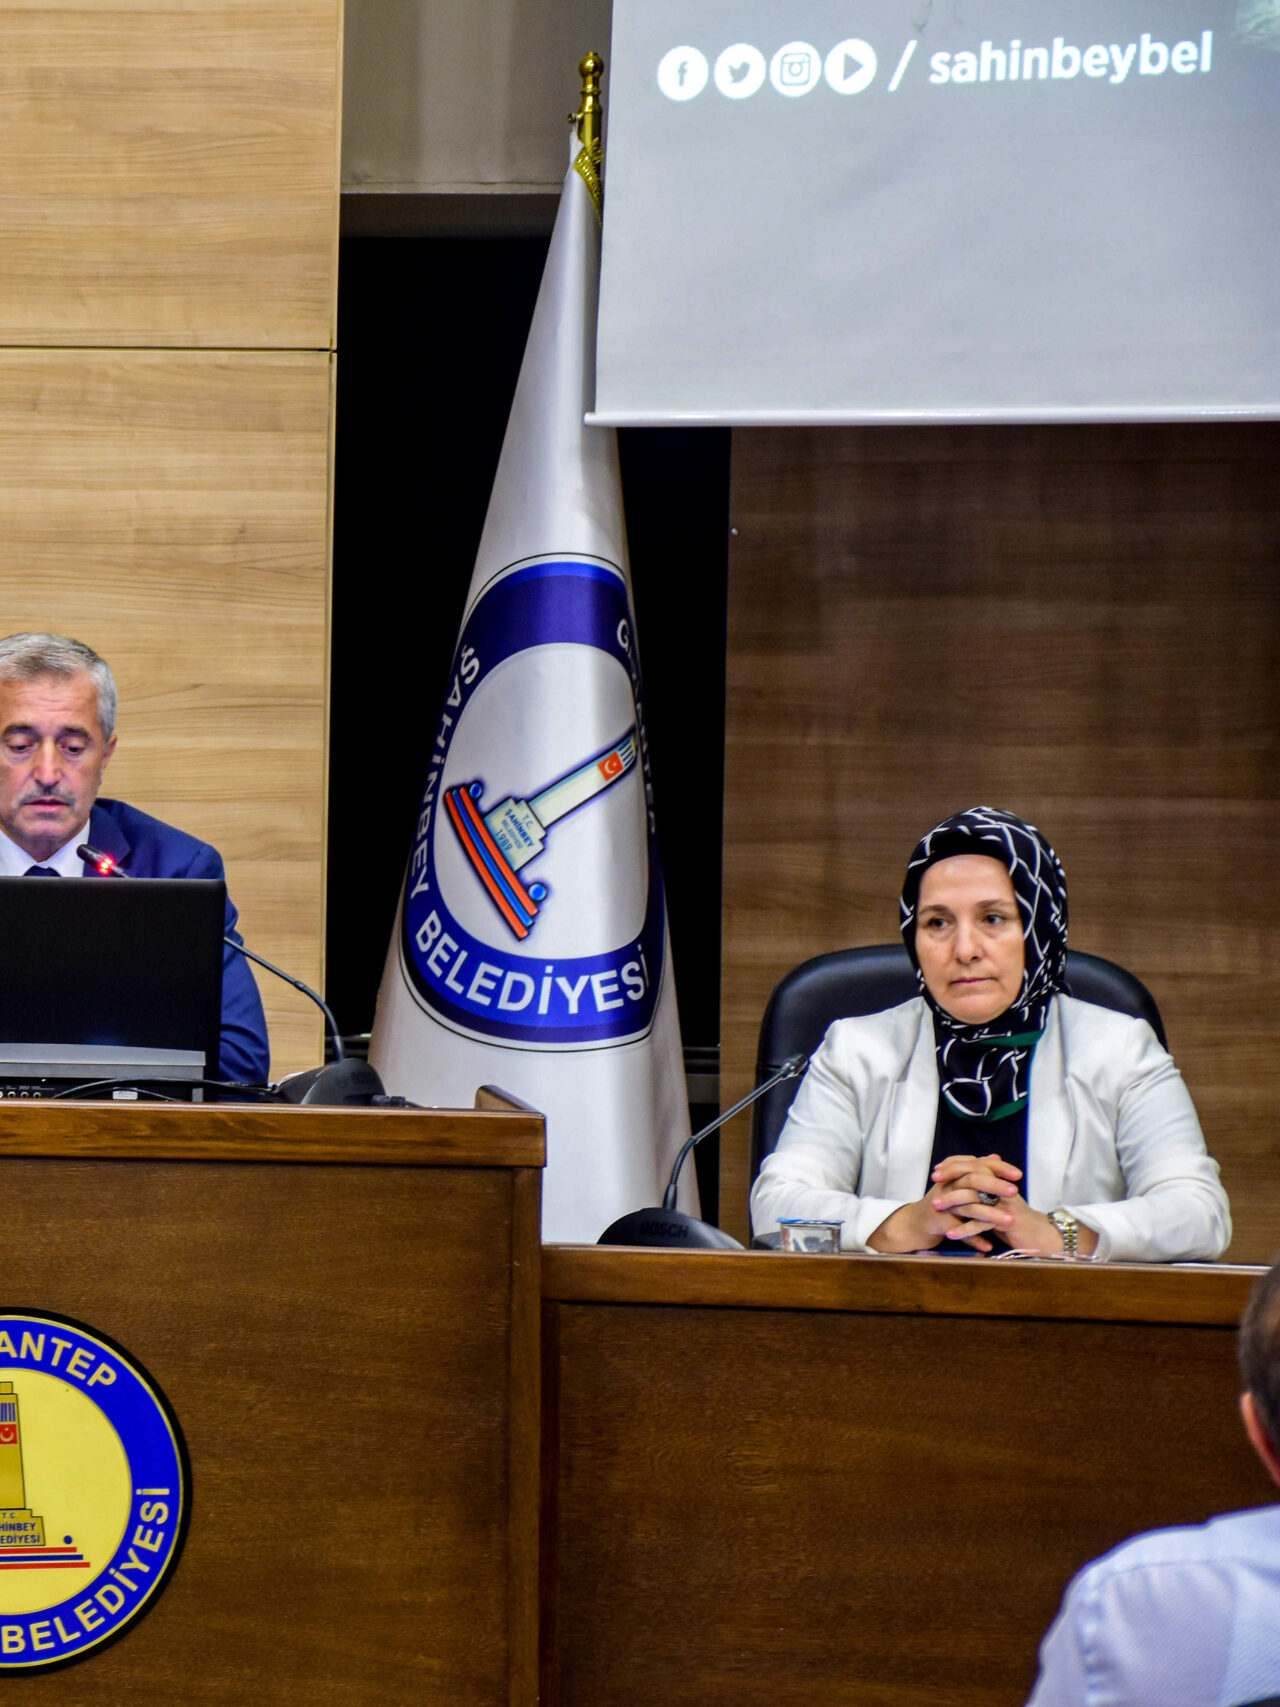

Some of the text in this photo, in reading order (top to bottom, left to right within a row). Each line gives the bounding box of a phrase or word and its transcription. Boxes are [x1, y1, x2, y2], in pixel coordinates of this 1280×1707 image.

[928, 30, 1214, 84] sahinbeybel
[410, 644, 650, 1015] ŞAHİNBEY BELEDİYESİ
[1, 1488, 170, 1654] BELEDİYESİ
